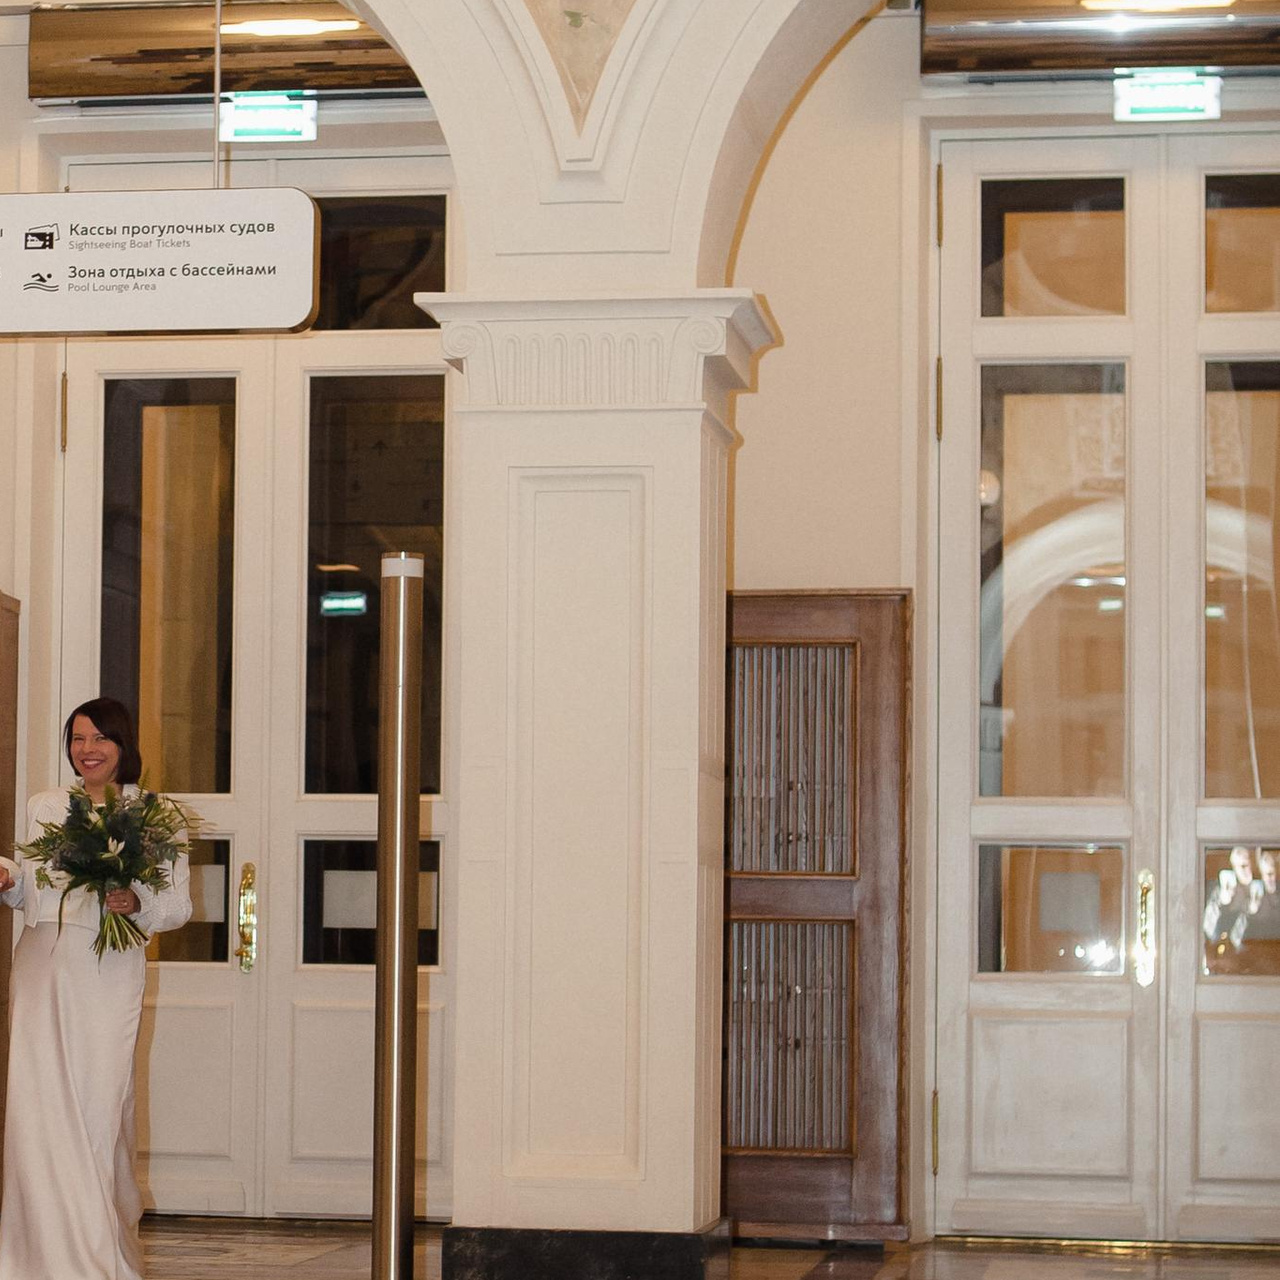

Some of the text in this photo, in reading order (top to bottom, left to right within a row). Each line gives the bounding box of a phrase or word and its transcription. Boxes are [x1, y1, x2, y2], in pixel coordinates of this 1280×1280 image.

[70, 222, 275, 237] Кассы прогулочных судов
[68, 238, 191, 251] Sightseeing Boat Tickets
[68, 263, 276, 280] Зона отдыха с бассейнами
[68, 281, 157, 293] Pool Lounge Area
